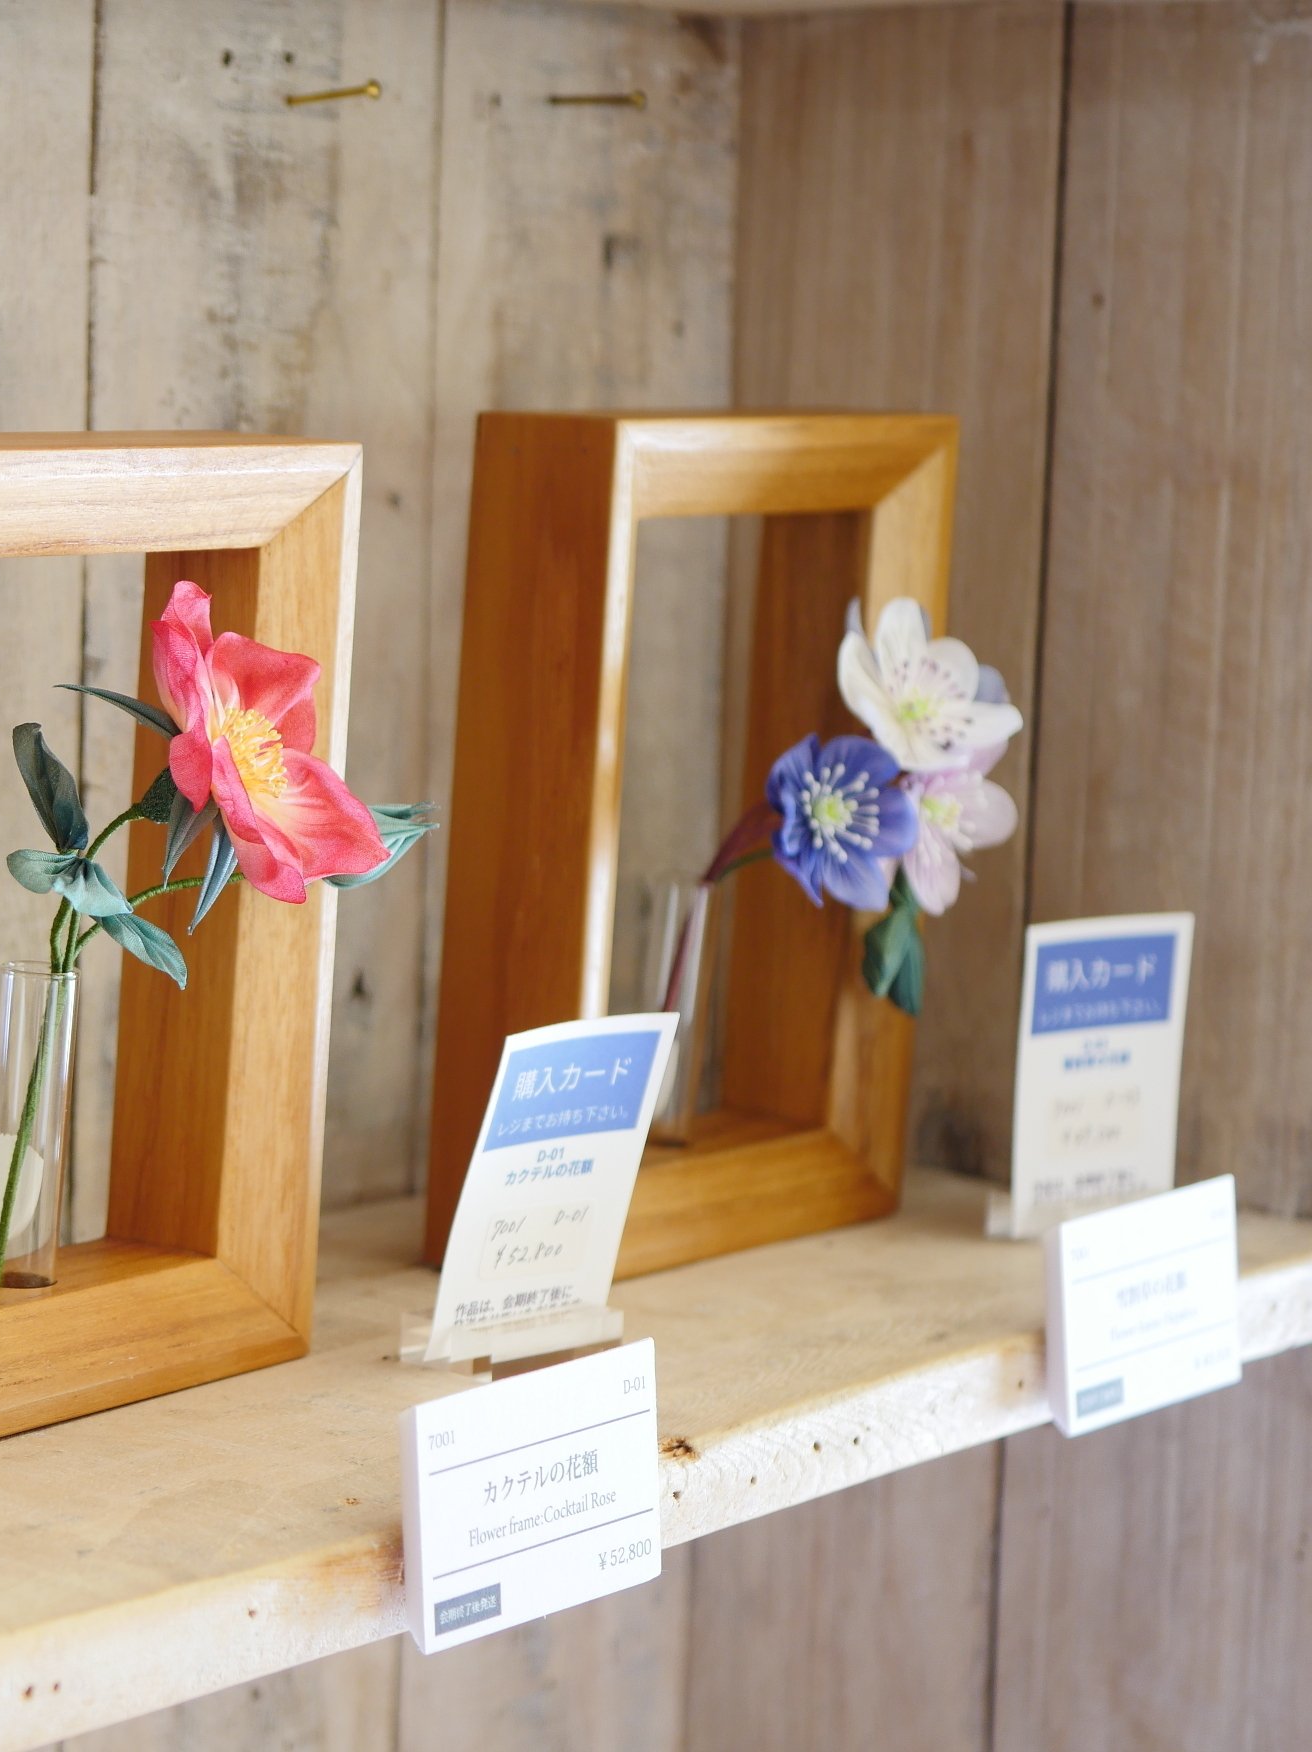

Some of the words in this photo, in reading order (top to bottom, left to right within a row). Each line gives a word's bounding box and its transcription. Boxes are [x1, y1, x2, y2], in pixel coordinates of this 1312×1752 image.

[512, 1057, 633, 1101] 購入カード
[498, 1104, 630, 1137] レジまでお持ち下さい。
[504, 1158, 594, 1187] カクテルの花額
[537, 1147, 565, 1162] D-01
[428, 1430, 456, 1450] 7001
[623, 1375, 646, 1395] D-01
[484, 1448, 599, 1505] カクテルの花額
[468, 1523, 507, 1548] Flower
[591, 1489, 617, 1510] Rose
[439, 1594, 497, 1625] 会期終了後発送
